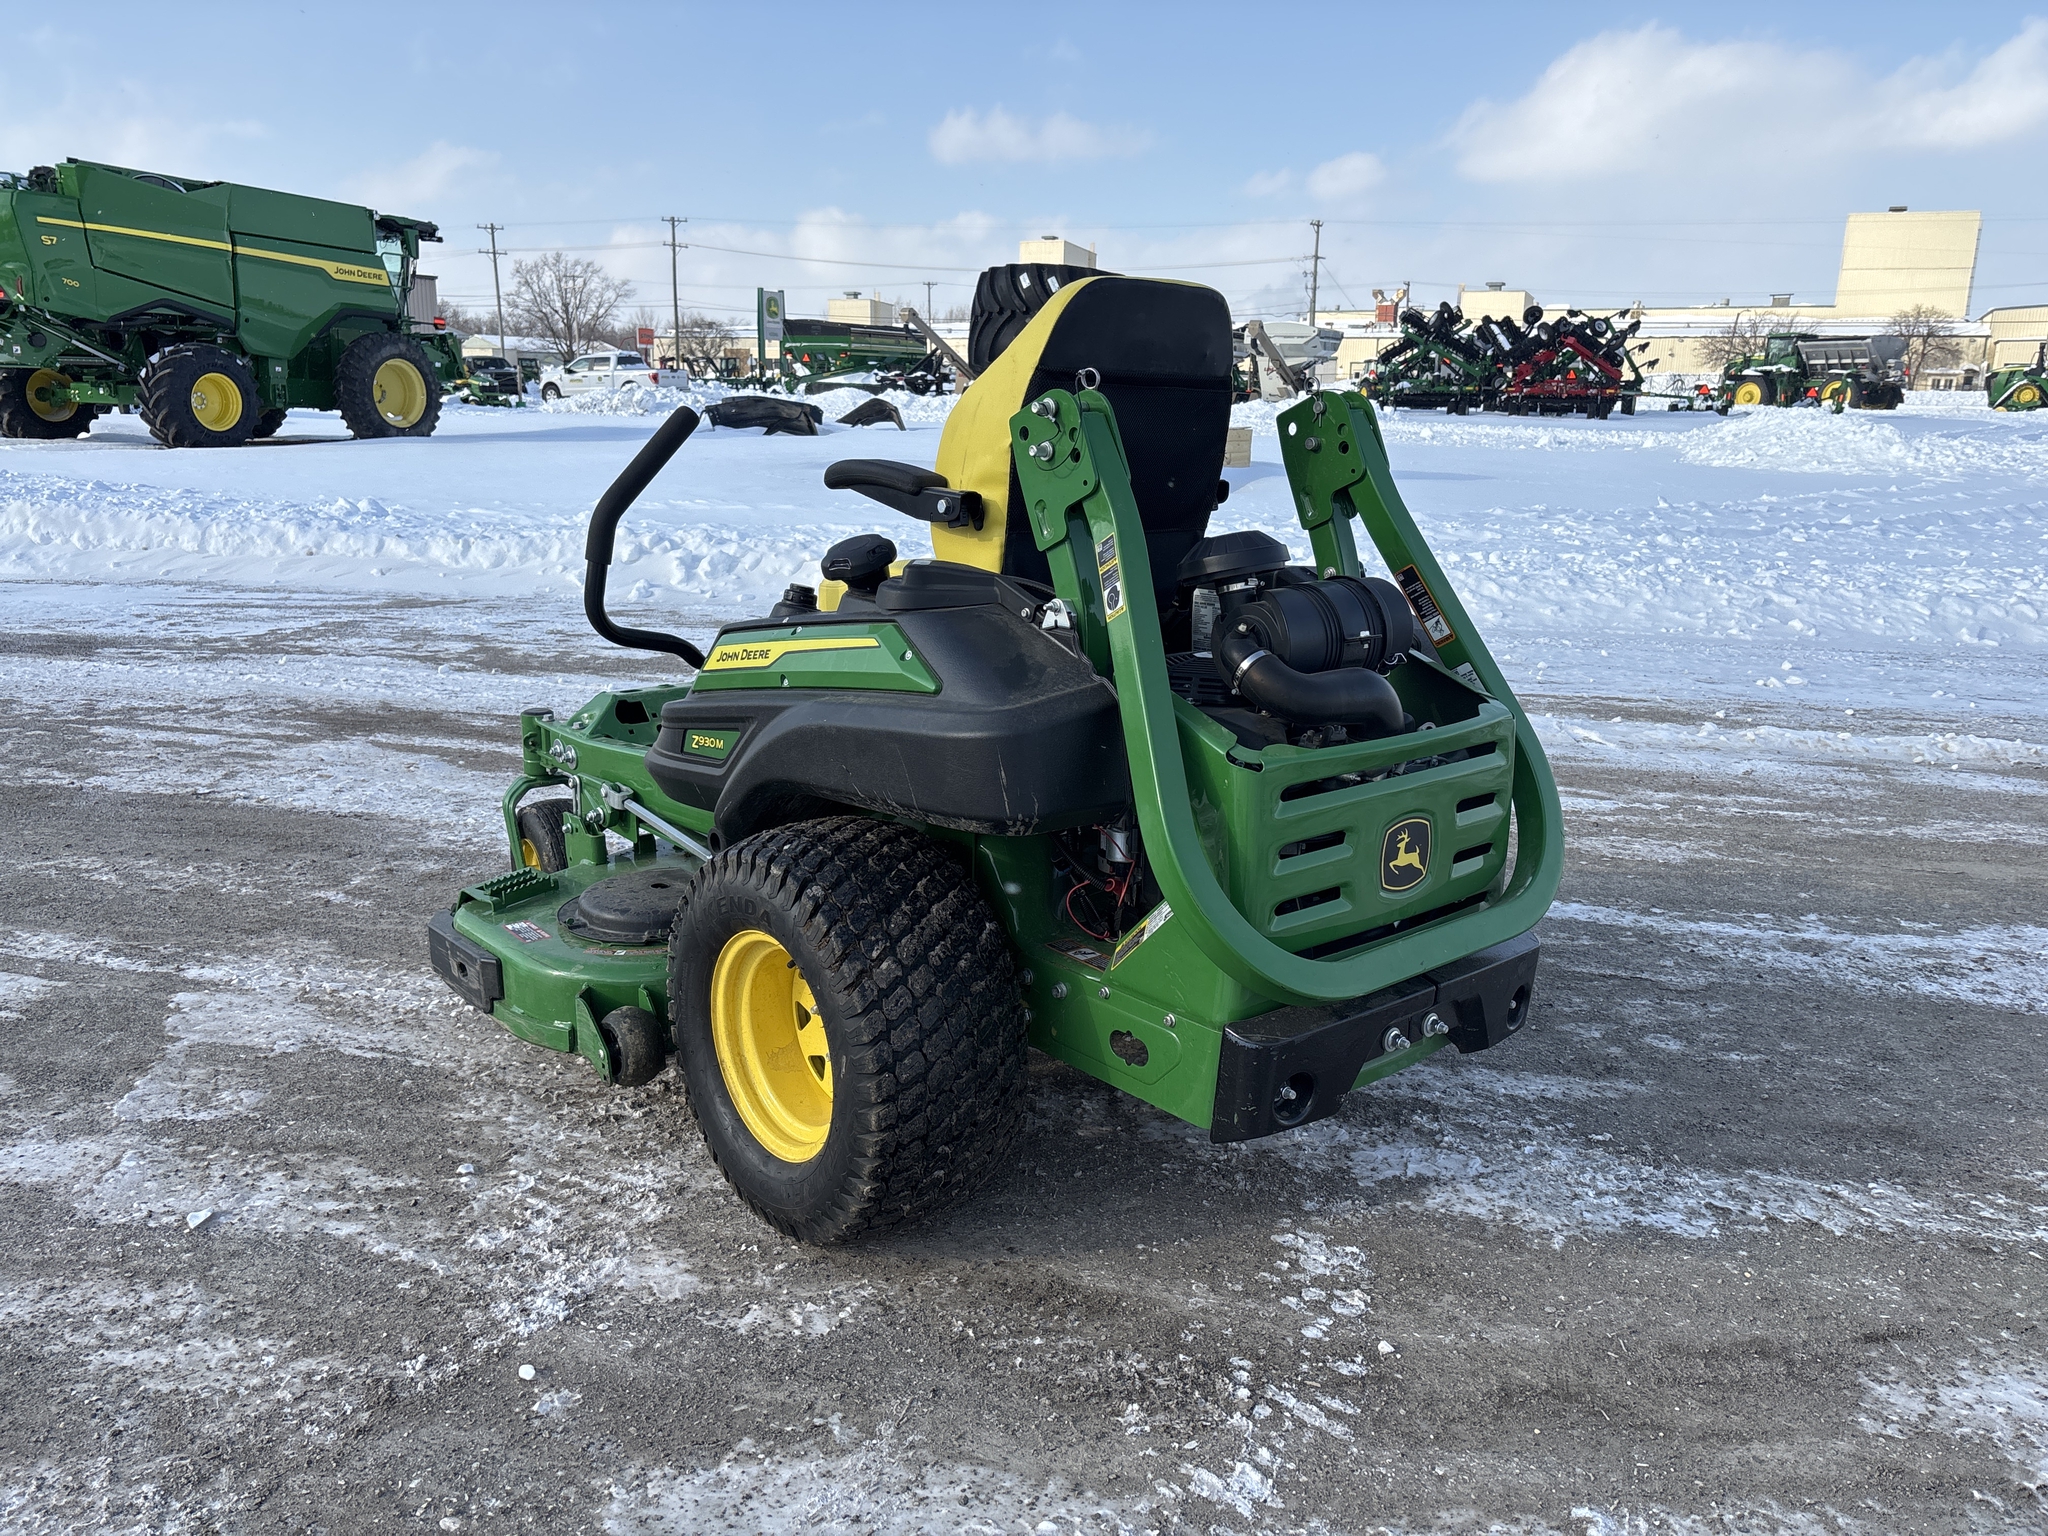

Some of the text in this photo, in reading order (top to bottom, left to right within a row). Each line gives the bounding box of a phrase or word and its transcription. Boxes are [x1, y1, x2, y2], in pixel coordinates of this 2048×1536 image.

[40, 235, 57, 246] S7
[334, 266, 384, 281] JOHN DEERE
[61, 277, 80, 288] 700
[716, 649, 772, 662] JOHN DEERE
[691, 734, 724, 750] Z930M
[703, 895, 776, 931] KENDA
